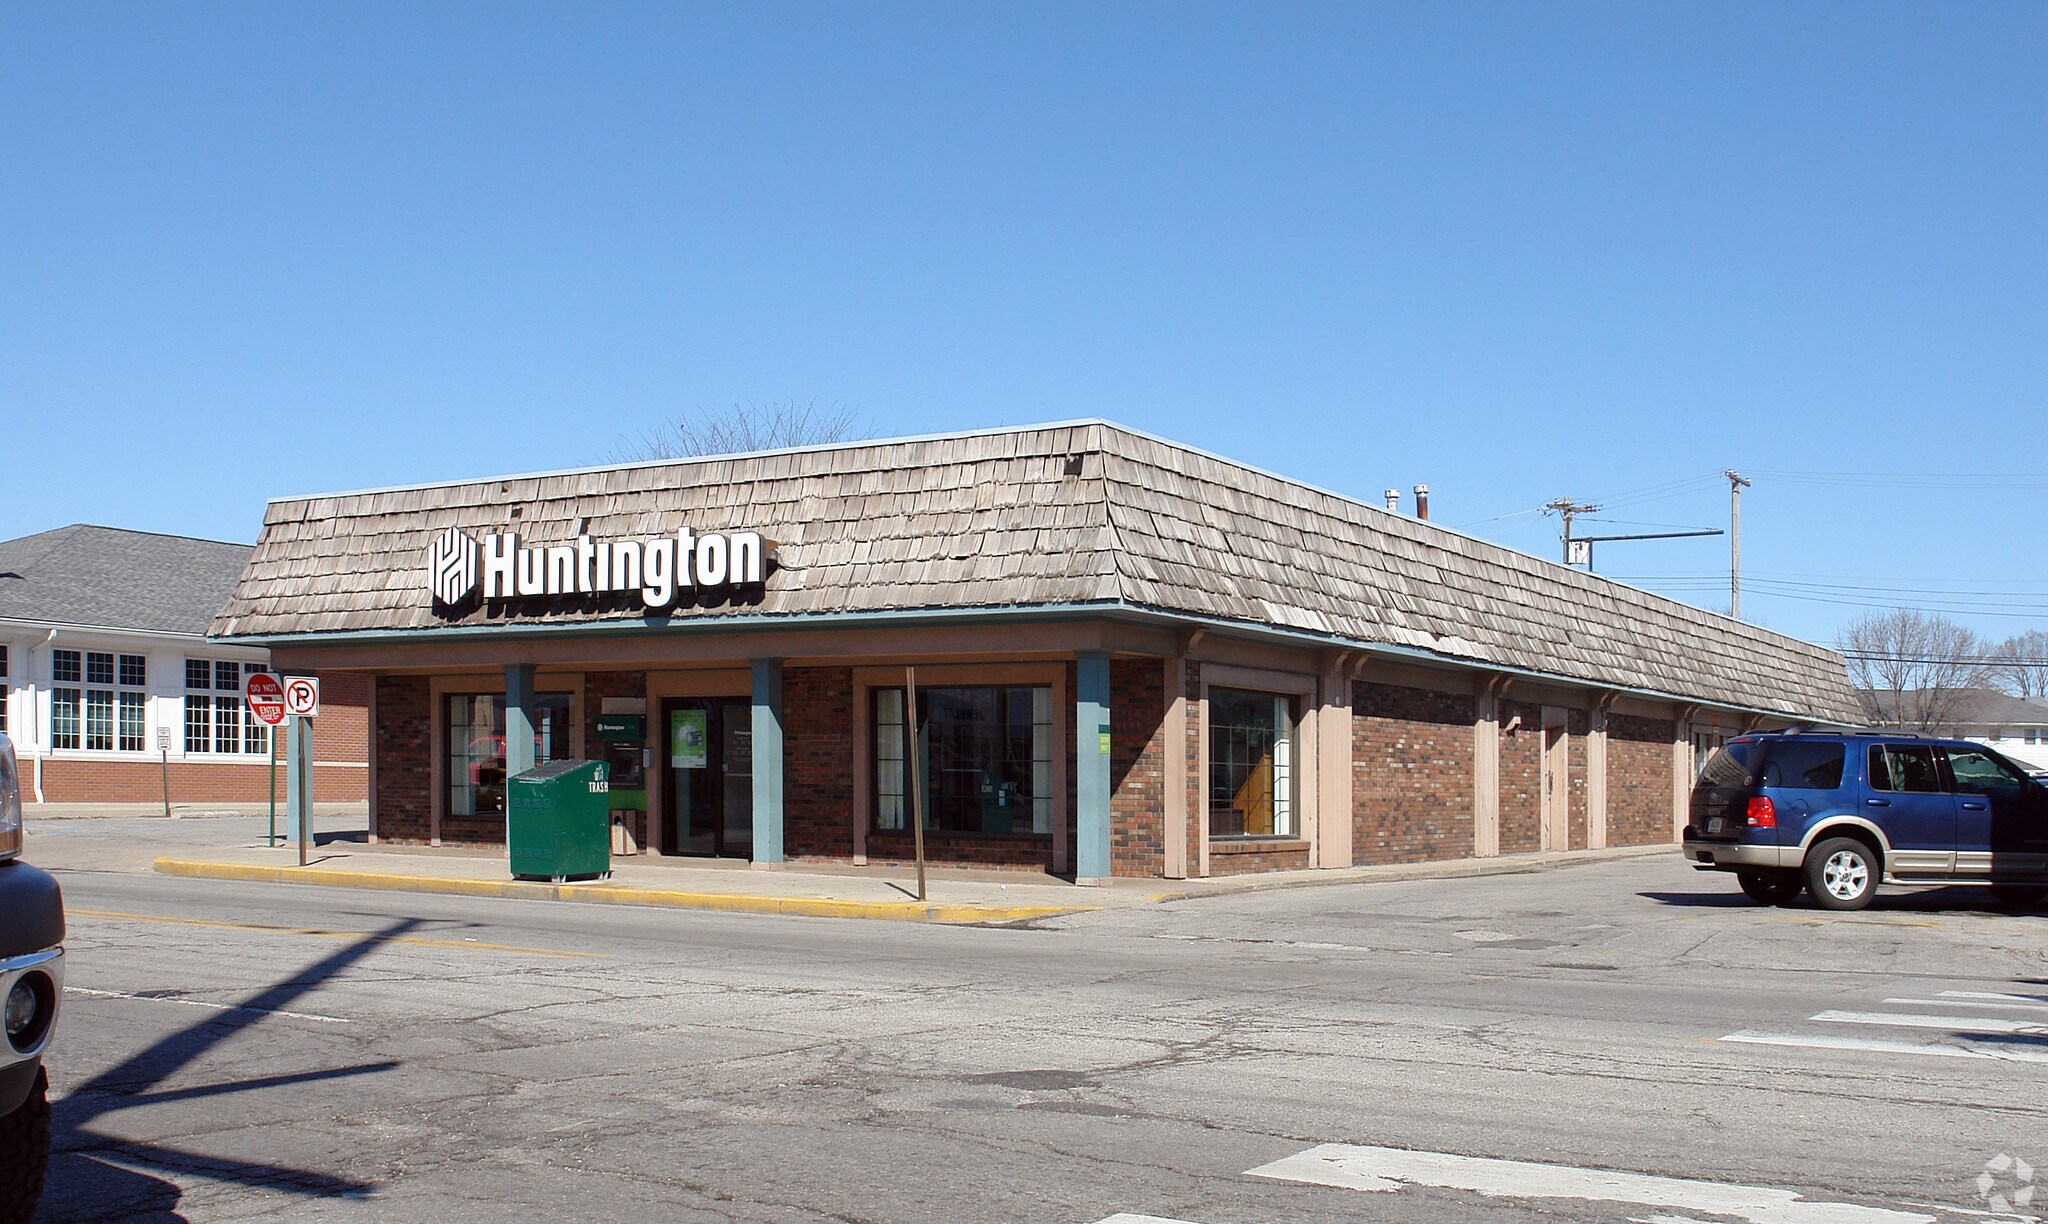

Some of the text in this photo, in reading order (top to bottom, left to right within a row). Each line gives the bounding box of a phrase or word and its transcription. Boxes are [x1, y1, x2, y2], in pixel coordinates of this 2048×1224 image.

[483, 526, 761, 607] Huntington
[250, 683, 277, 693] DO NOT
[259, 706, 282, 715] ENTER
[588, 781, 609, 793] TRASH
